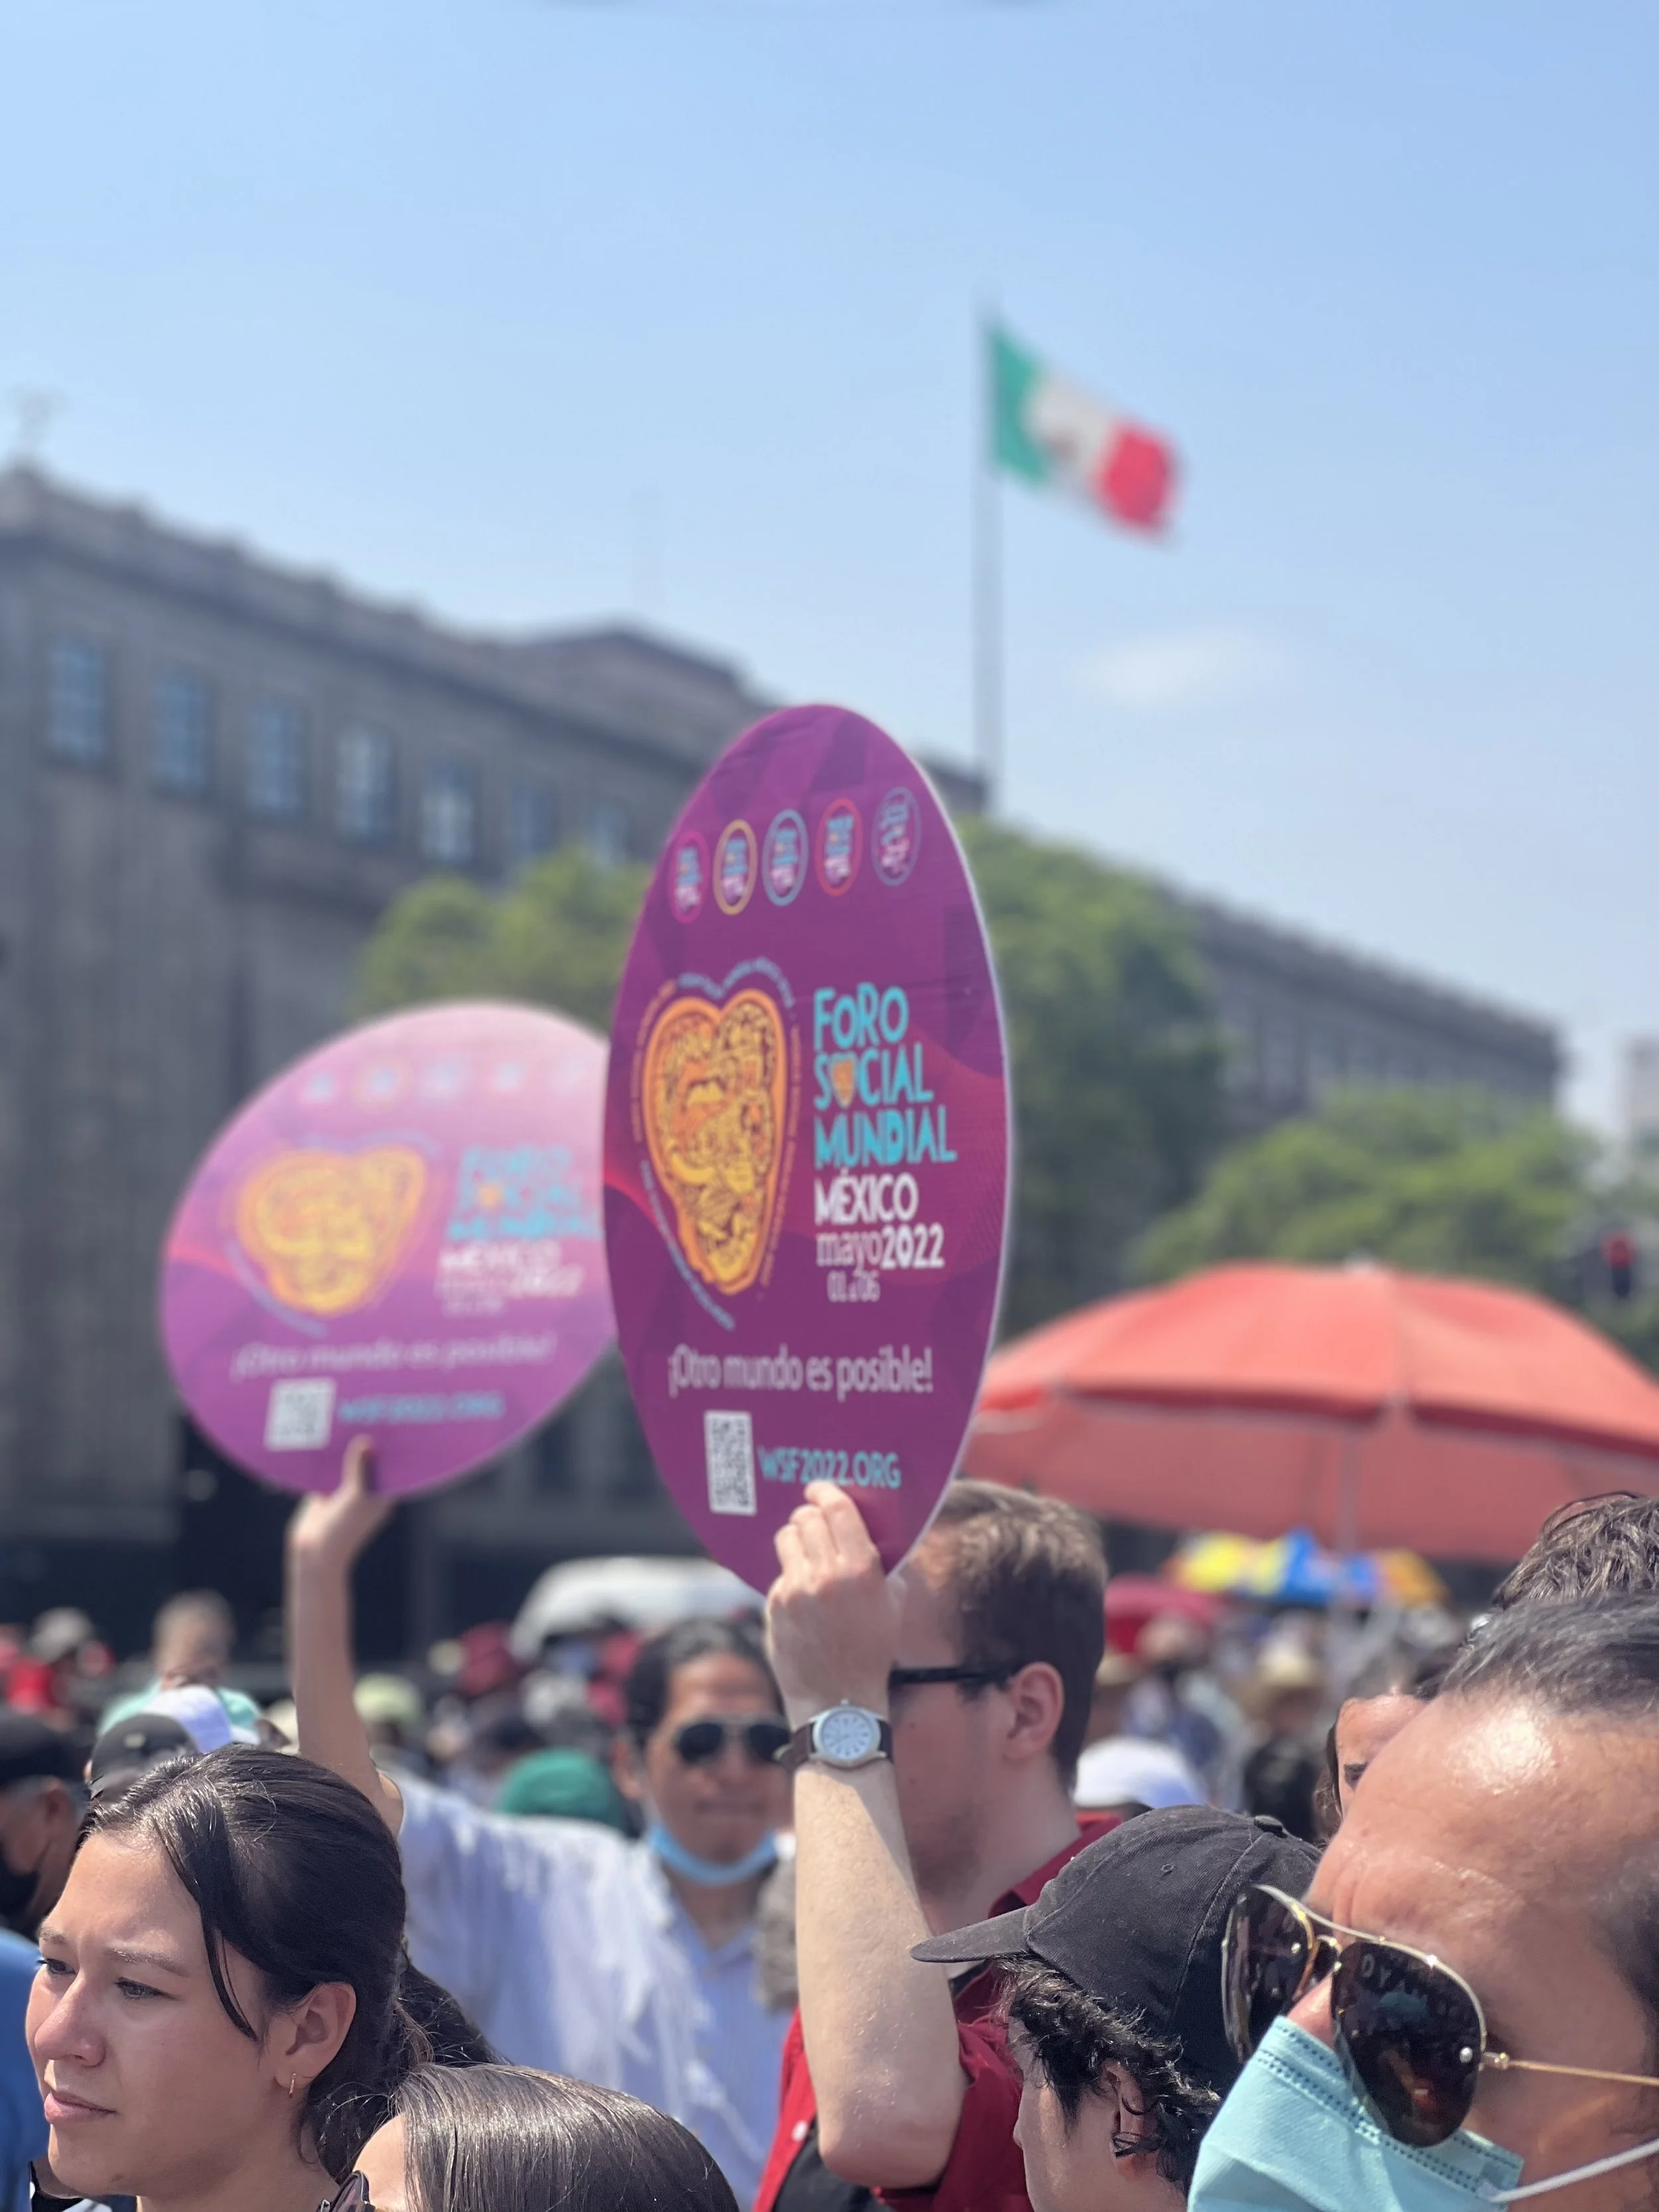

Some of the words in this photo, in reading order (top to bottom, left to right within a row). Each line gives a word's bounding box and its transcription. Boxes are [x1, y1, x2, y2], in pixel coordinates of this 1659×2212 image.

[814, 982, 908, 1051] FORO
[814, 1105, 956, 1169] MUNDIAL
[814, 1168, 919, 1224] MÉXICO
[723, 1343, 804, 1390] mundo
[806, 1356, 833, 1392] es
[836, 1344, 933, 1403] posible!
